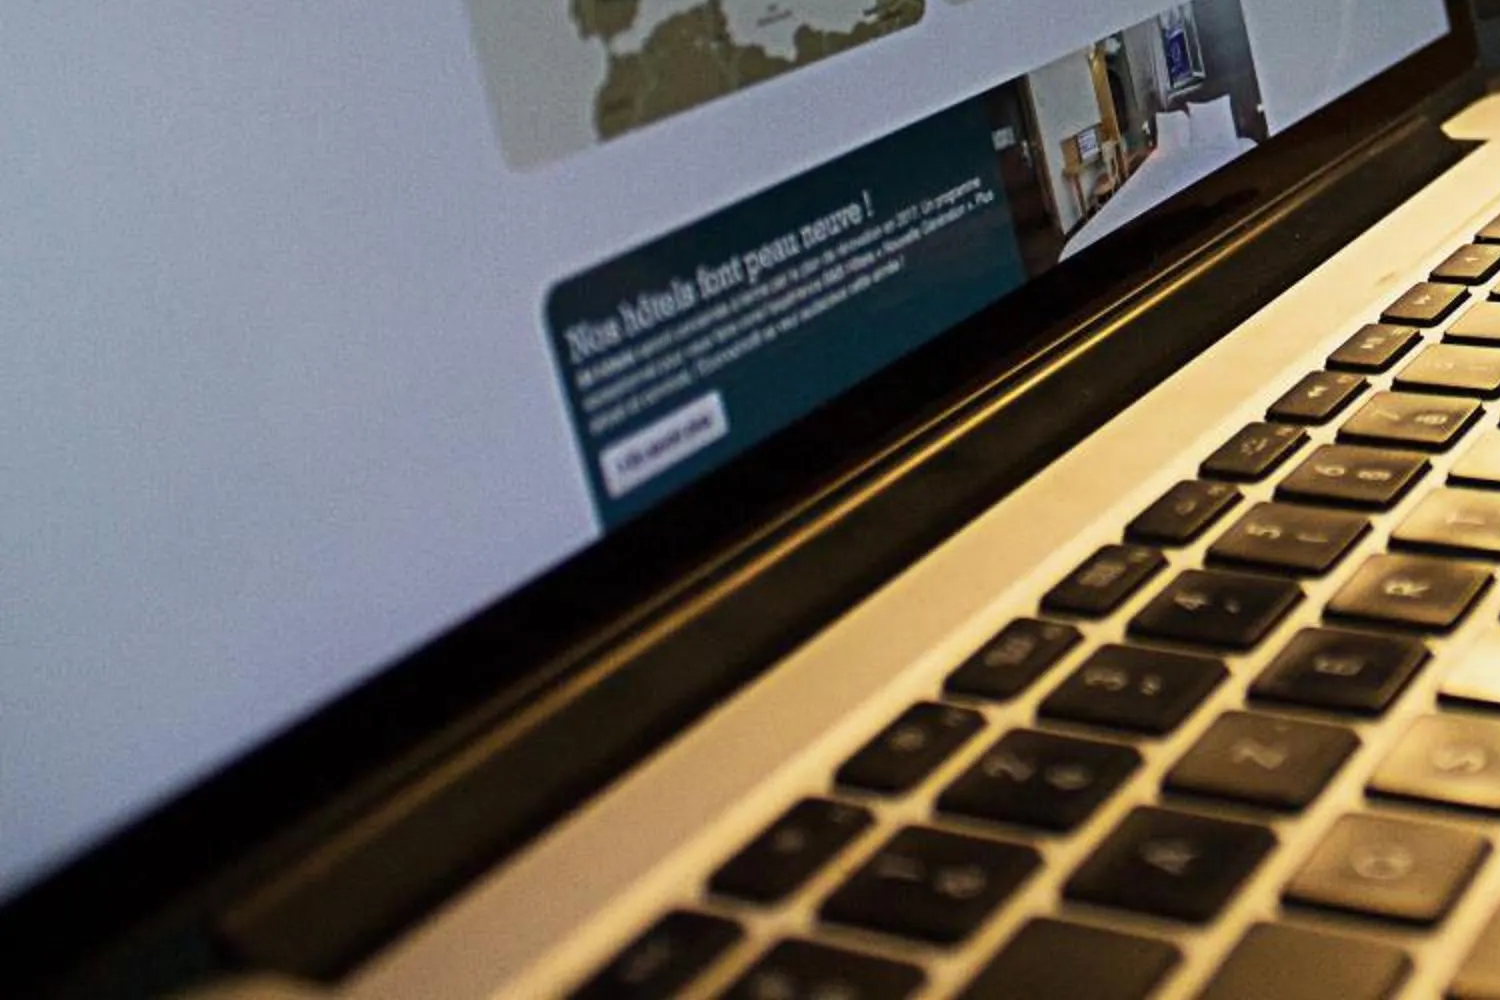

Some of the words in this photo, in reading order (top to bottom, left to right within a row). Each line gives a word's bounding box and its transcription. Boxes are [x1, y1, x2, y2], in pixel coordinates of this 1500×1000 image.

[564, 317, 622, 365] Nos
[616, 275, 697, 339] hôtels
[695, 253, 744, 300] font
[742, 232, 801, 284] peau
[799, 202, 863, 250] neuve
[862, 188, 874, 219] !
[1314, 463, 1346, 478] 6
[1245, 522, 1284, 541] 5
[1383, 578, 1432, 600] R
